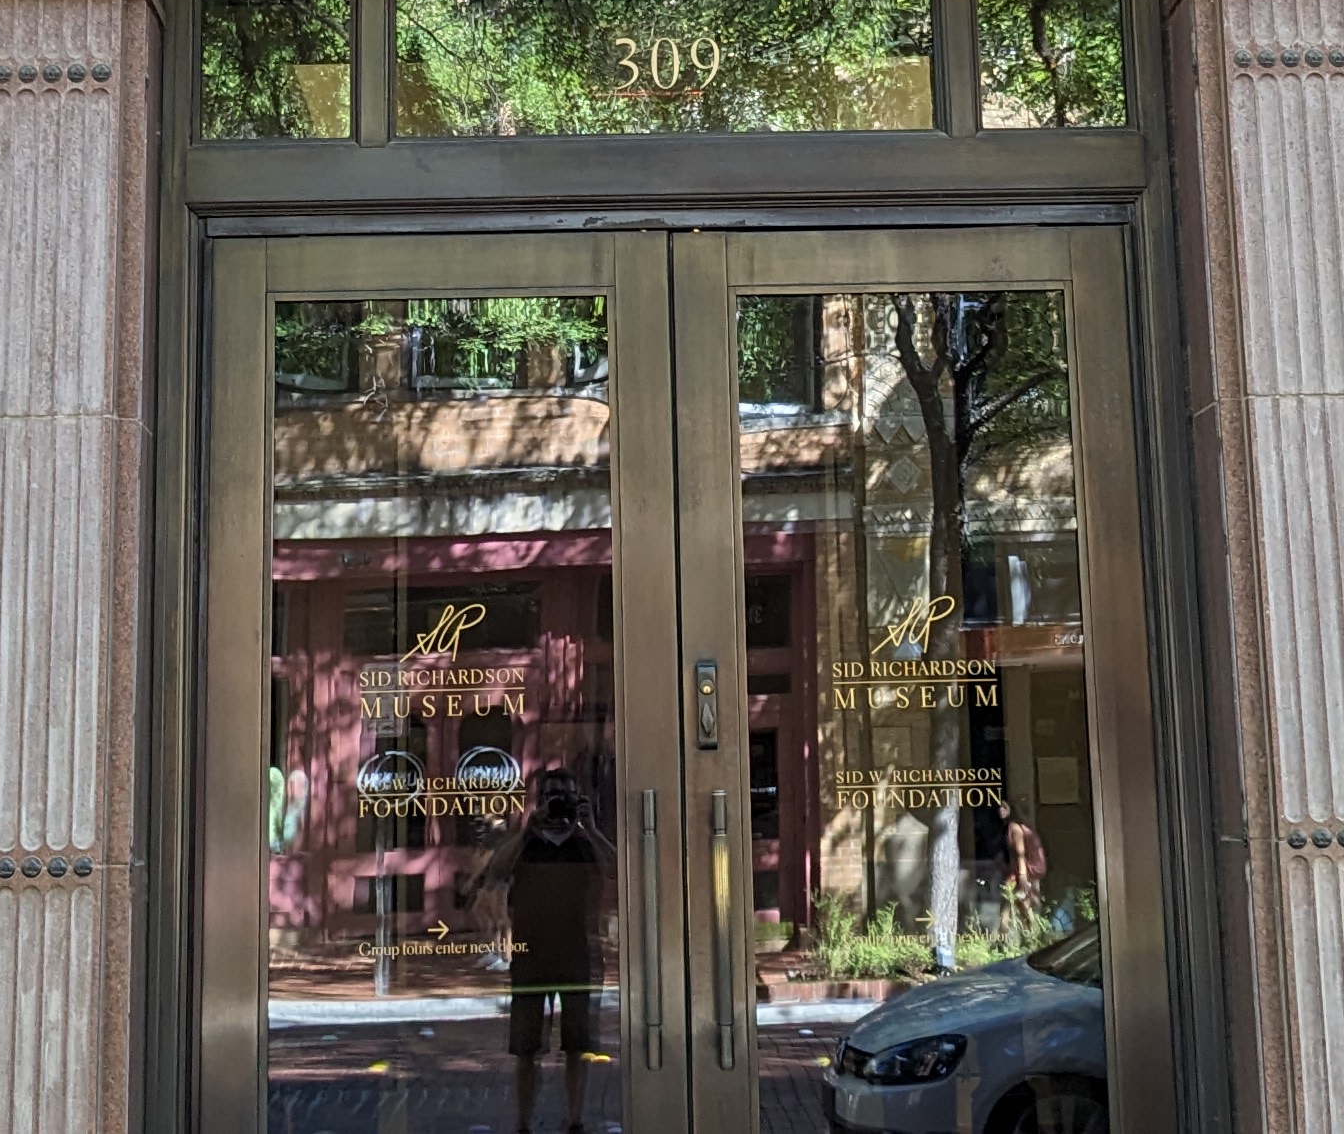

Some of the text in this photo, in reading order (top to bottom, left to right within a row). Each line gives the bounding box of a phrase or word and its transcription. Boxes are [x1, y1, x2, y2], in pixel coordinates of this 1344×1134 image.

[613, 37, 720, 91] 309
[359, 668, 525, 688] SID RICHARDSON
[833, 659, 996, 678] SID RICHARDSON
[359, 693, 525, 718] MUSEUM
[833, 685, 998, 710] MUSEUM
[416, 777, 526, 791] RICHARDSON
[836, 770, 863, 784] SID
[893, 767, 1002, 783] RICHARDSON
[358, 794, 526, 818] FOUNDATION
[836, 787, 1003, 810] FOUNDATION
[358, 942, 400, 960] Group
[402, 942, 433, 955] tours
[435, 943, 467, 955] enter
[470, 941, 496, 954] next
